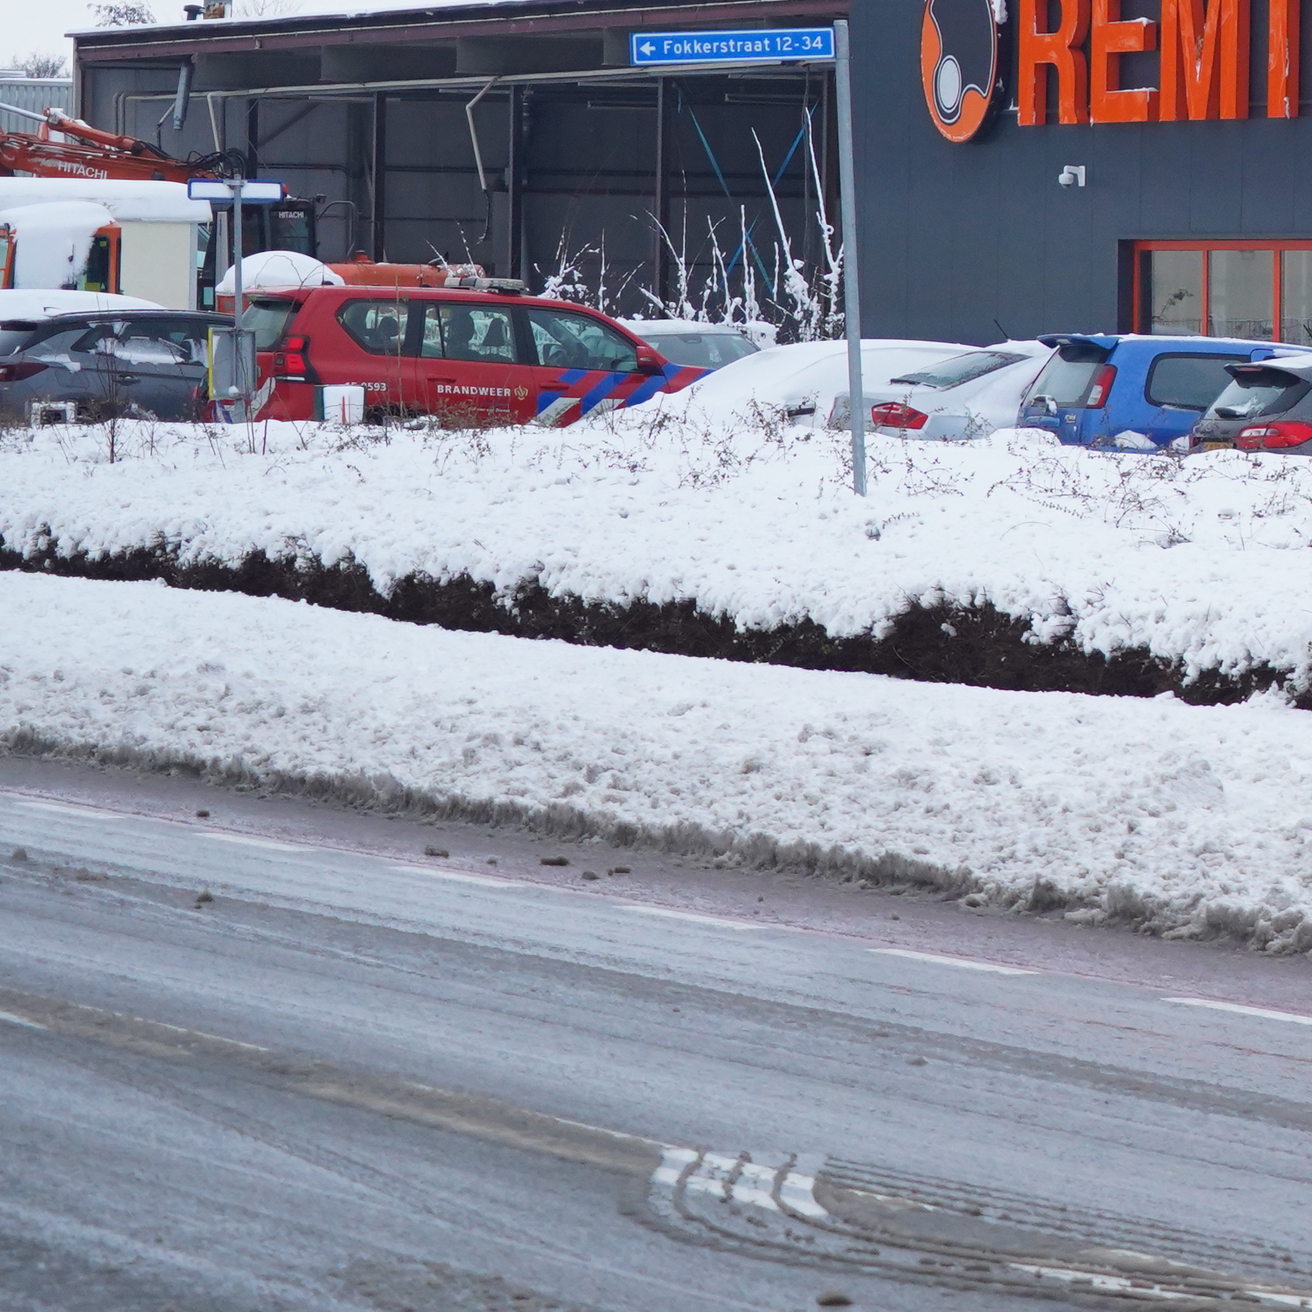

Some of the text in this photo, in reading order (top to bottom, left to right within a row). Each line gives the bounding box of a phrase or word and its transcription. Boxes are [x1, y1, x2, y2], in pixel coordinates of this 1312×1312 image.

[663, 36, 823, 55] Fokkerstraat 12-34
[57, 160, 108, 179] HITACHI
[278, 211, 305, 219] HITACHI
[344, 381, 387, 392] 0593
[437, 384, 511, 397] BRANDWEER
